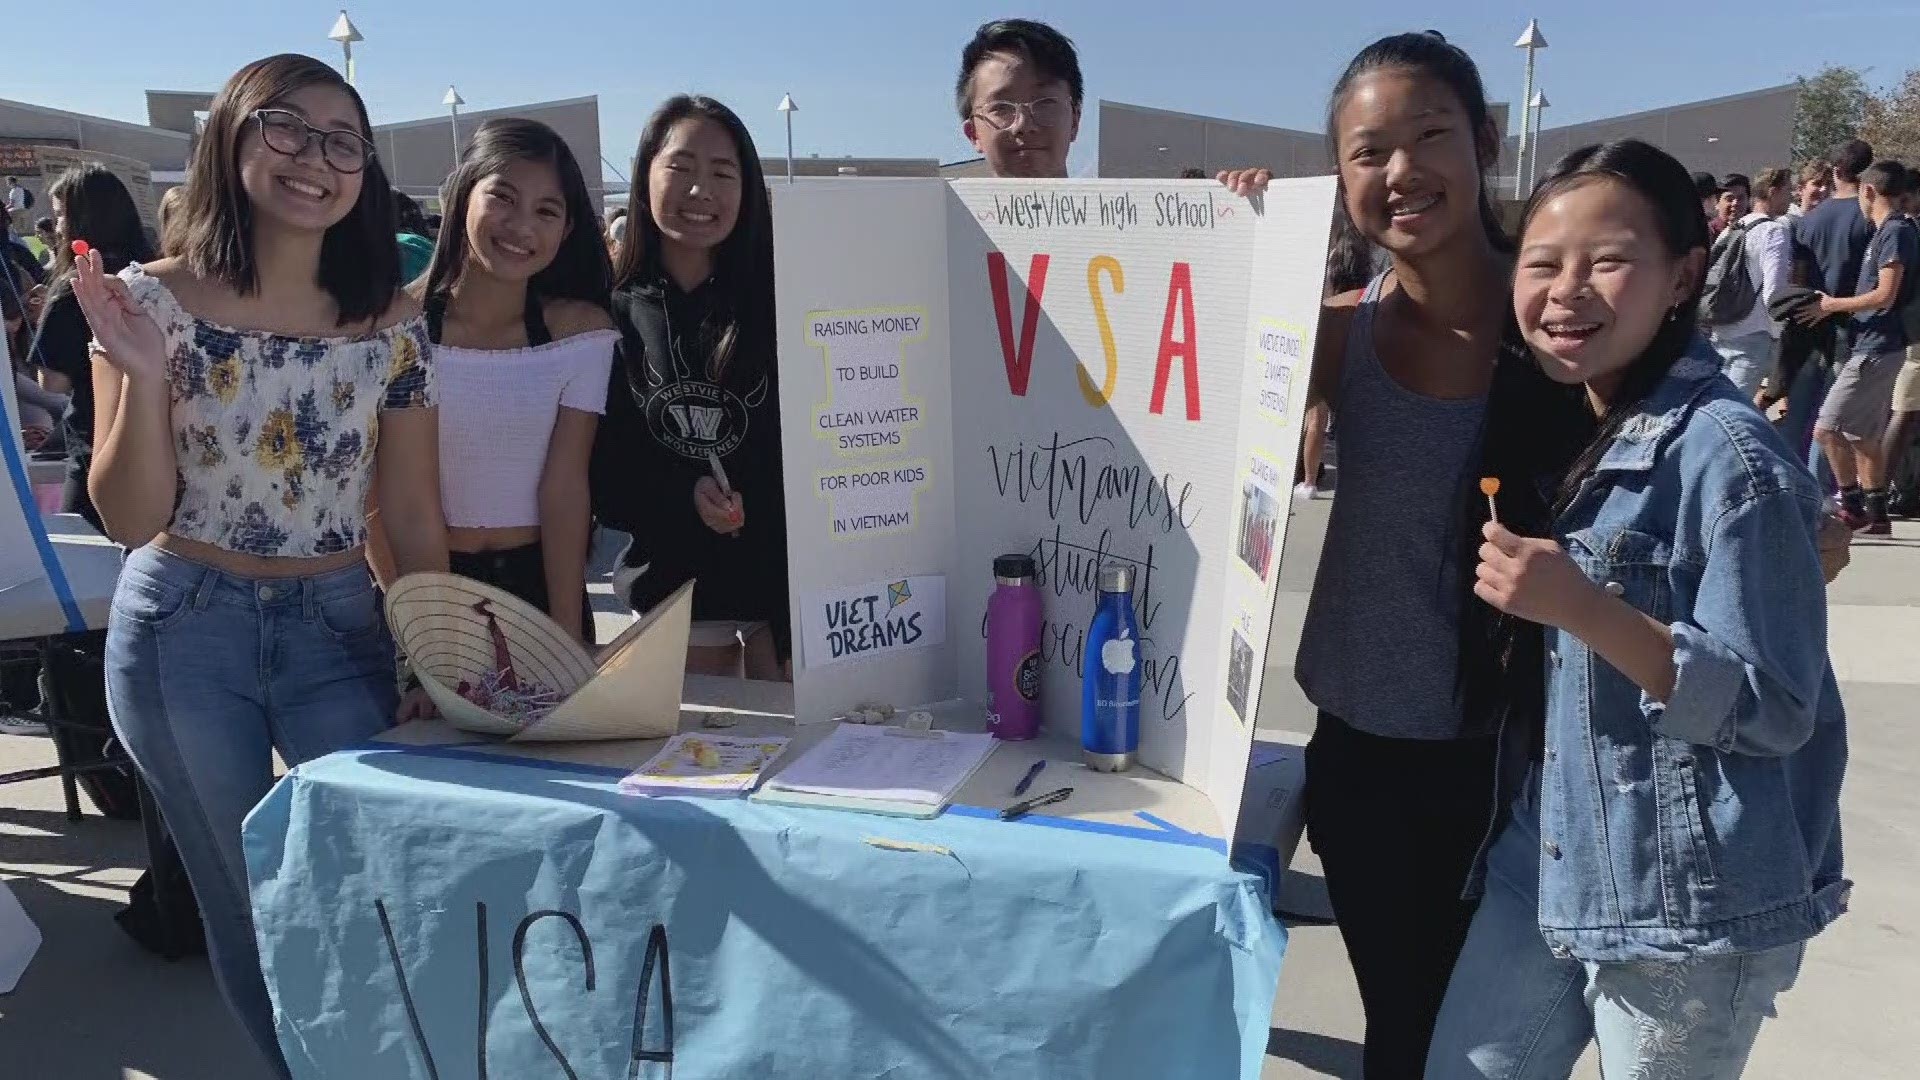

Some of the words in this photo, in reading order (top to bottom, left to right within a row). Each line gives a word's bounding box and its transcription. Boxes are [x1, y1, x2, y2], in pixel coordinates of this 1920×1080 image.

[814, 319, 868, 337] RAISING
[872, 316, 921, 334] MONEY
[986, 251, 1201, 421] VSA
[836, 367, 855, 382] TO
[860, 364, 899, 381] BUILD
[819, 411, 864, 429] CLEAN
[867, 407, 919, 425] WATER
[663, 432, 739, 457] WOLVERINES
[839, 431, 901, 449] SYSTEMS
[820, 475, 847, 491] FOR
[851, 471, 890, 488] POOR
[894, 467, 925, 483] KIDS
[833, 519, 846, 533] IN
[850, 512, 910, 531] VIETNAM
[826, 611, 923, 658] DREAMS
